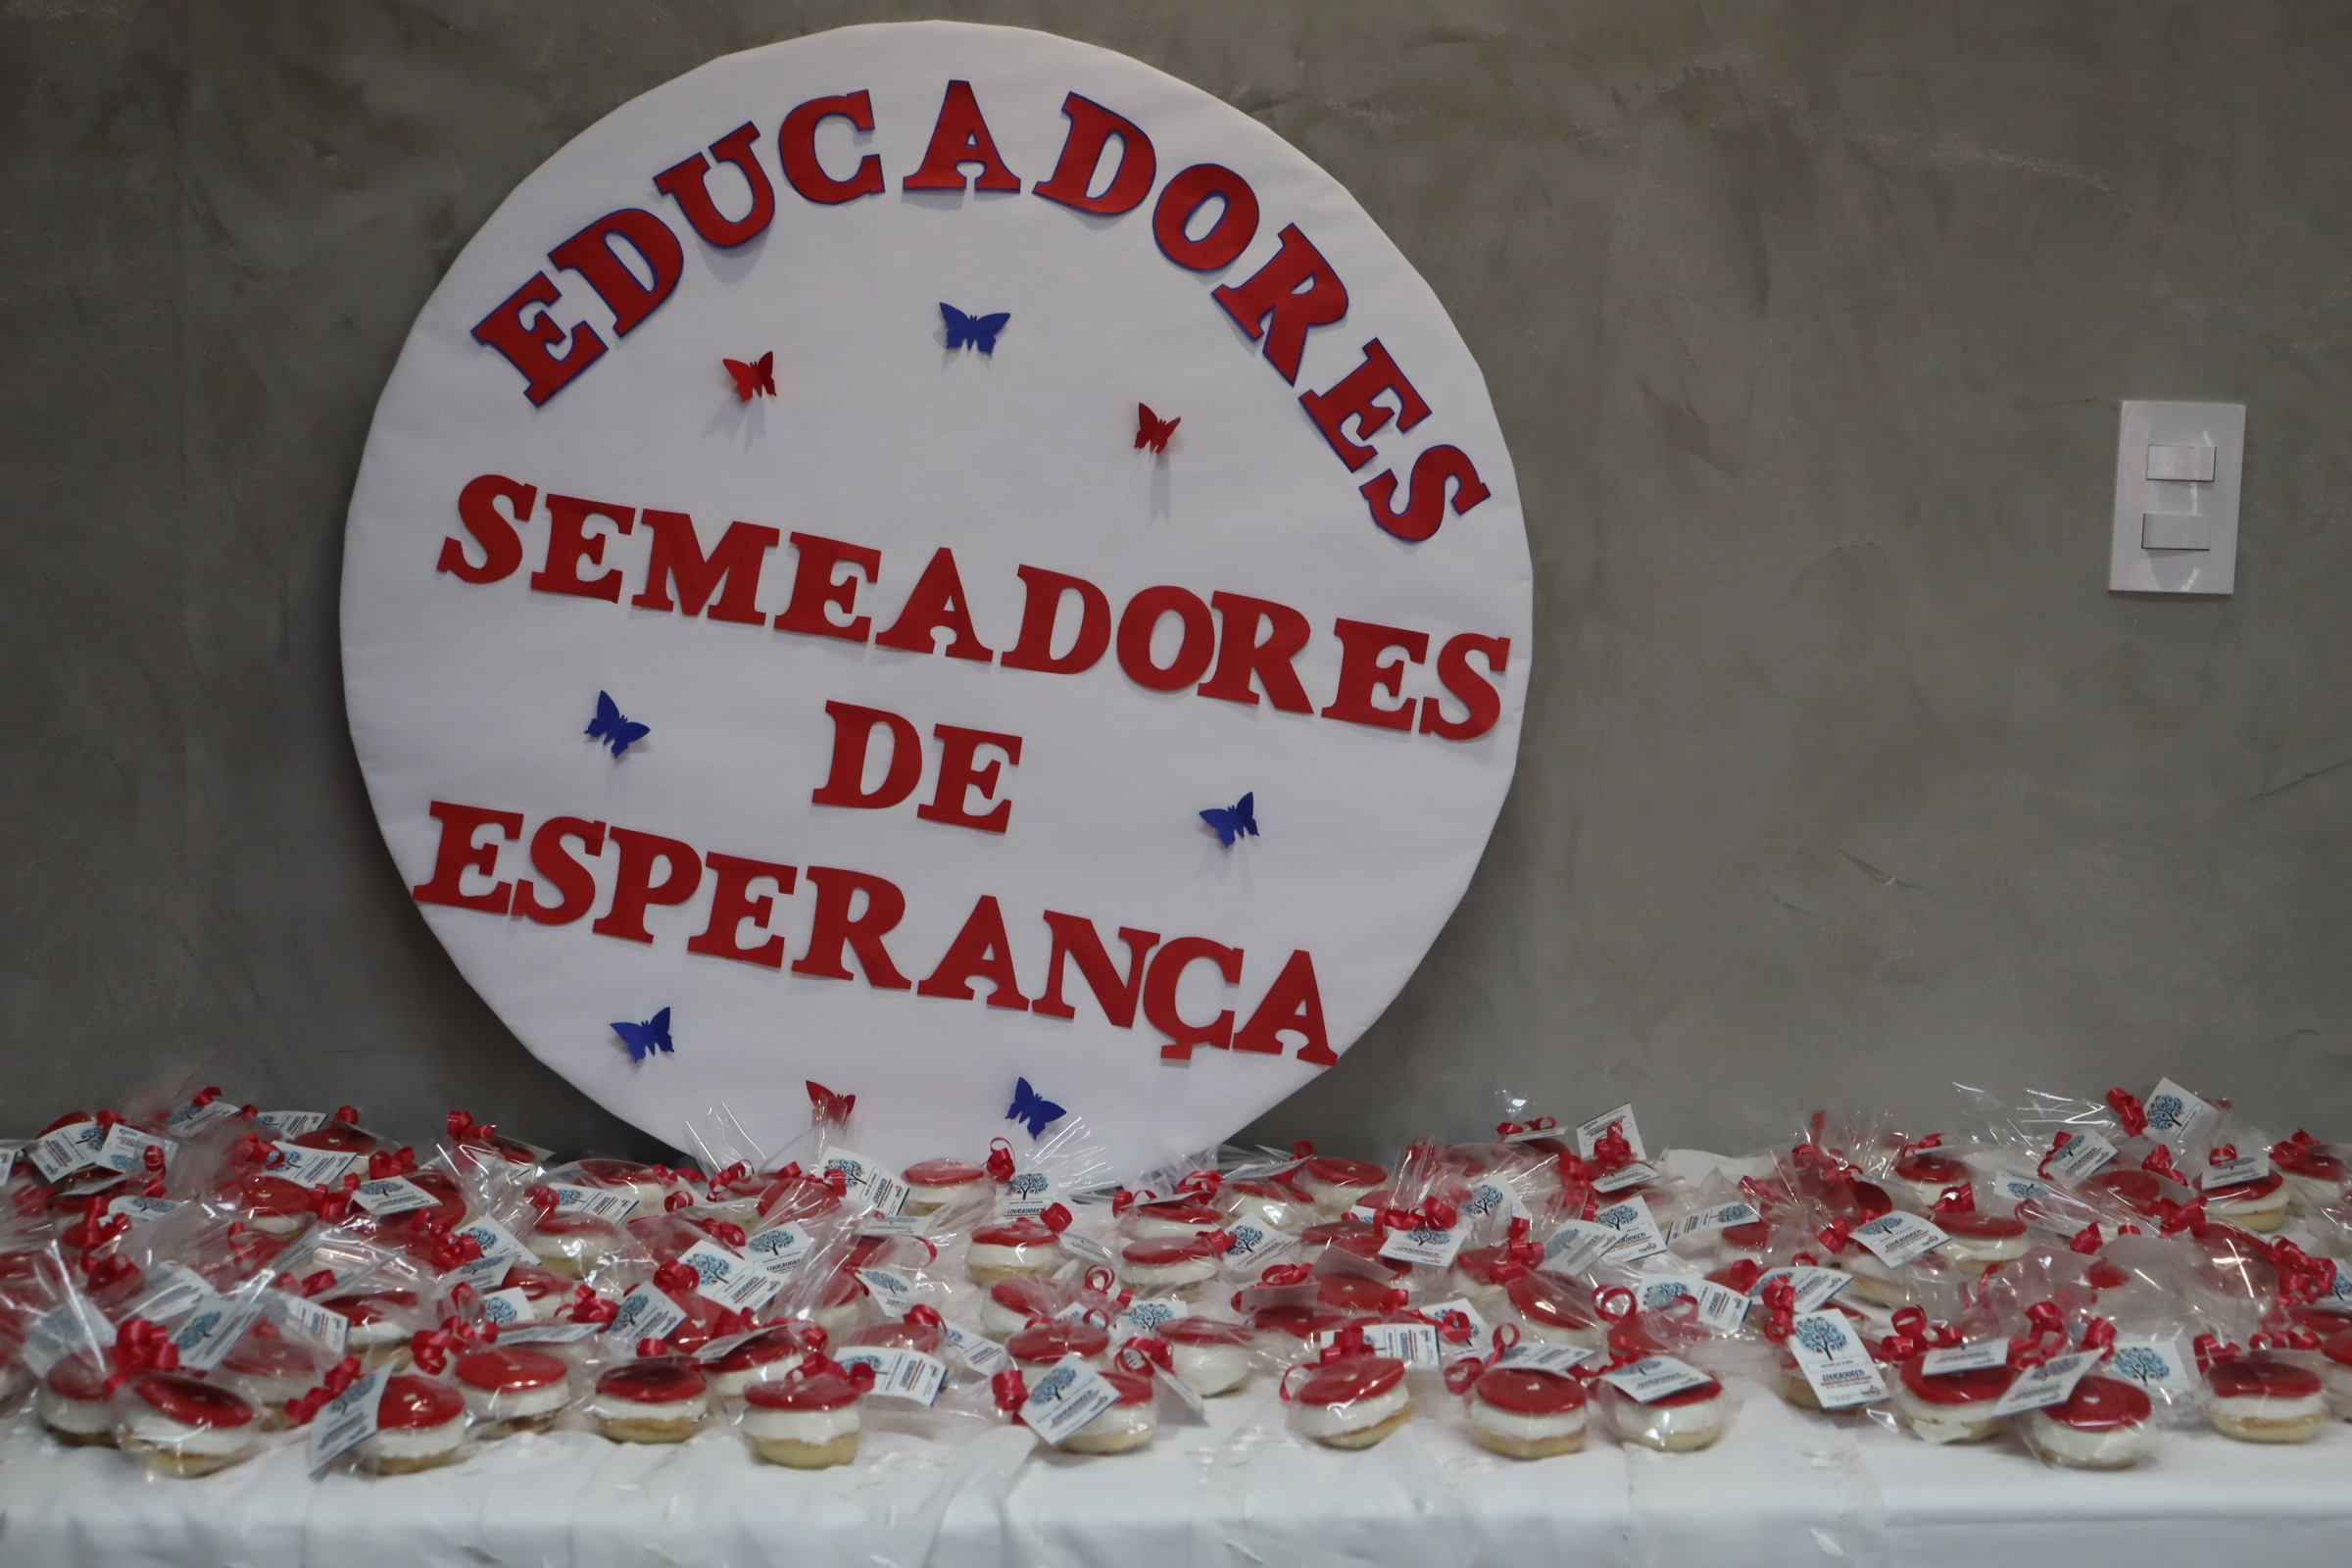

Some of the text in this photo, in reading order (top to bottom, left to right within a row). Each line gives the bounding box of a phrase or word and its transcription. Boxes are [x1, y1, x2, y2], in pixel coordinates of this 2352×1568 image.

[471, 80, 1490, 544] EDUCADORES
[437, 474, 1511, 741] SEMEADORES
[812, 700, 1024, 833] DE
[413, 800, 1339, 1068] ESPERANÇA
